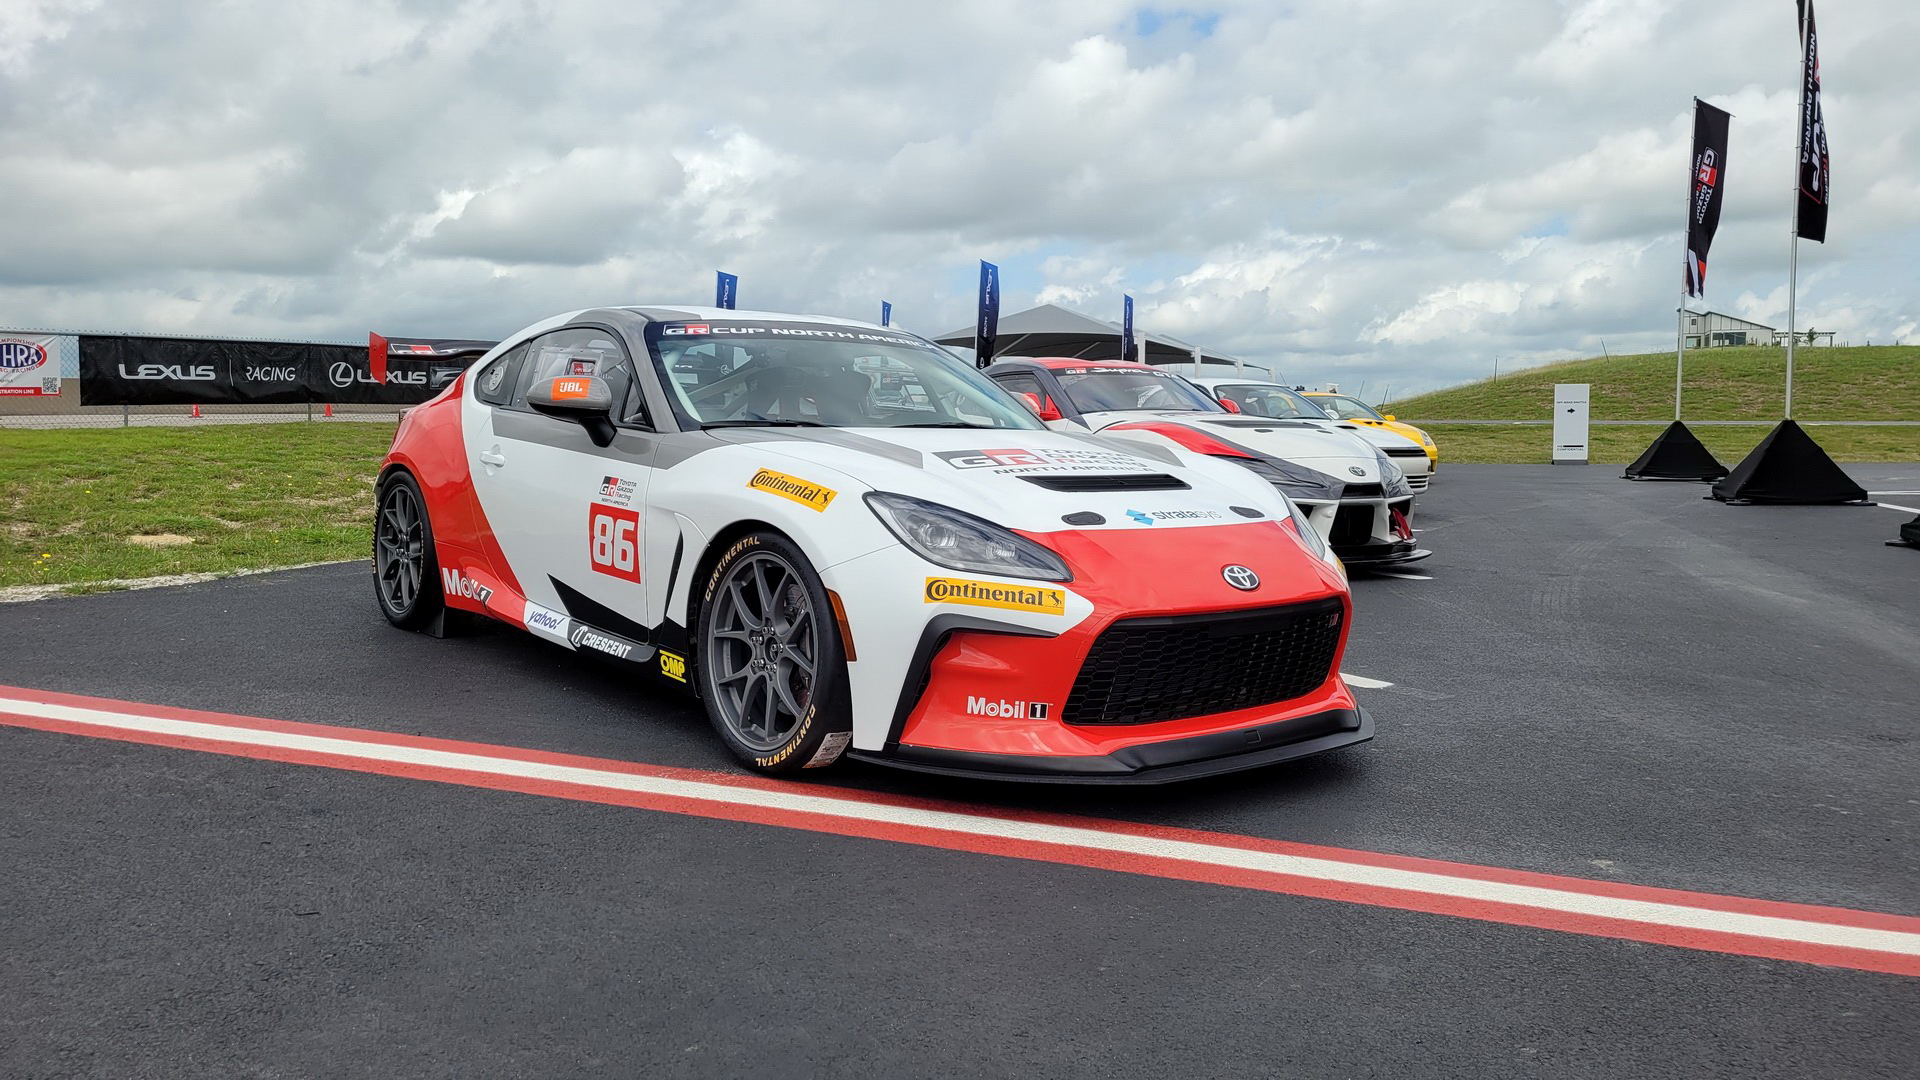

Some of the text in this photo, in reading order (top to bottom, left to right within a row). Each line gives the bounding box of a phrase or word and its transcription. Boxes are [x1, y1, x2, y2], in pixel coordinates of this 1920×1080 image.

[1802, 33, 1816, 163] NORTH AMERICA
[1698, 149, 1715, 183] GR
[1699, 188, 1713, 224] TOYOTA
[664, 326, 709, 335] GR
[771, 328, 854, 338] NORTH
[859, 334, 939, 351] AMERICA
[2, 344, 38, 367] HRA
[12, 365, 36, 374] RACING
[118, 364, 296, 381] LEXUS RACING
[357, 369, 426, 384] LXUS
[560, 382, 582, 392] JBL
[948, 452, 1045, 469] GR
[994, 466, 1068, 474] NORTH
[600, 484, 615, 496] GR
[616, 486, 634, 494] GAZOO
[620, 479, 637, 488] TOYOTA
[750, 470, 822, 502] Continental
[614, 492, 632, 502] Racing
[1152, 510, 1222, 520] stratasys
[592, 514, 635, 572] 86
[704, 536, 760, 602] CONTINENTAL
[926, 580, 1044, 606] Continental
[528, 610, 564, 630] yahoo!
[582, 632, 632, 658] CRESCENT
[660, 654, 686, 678] OMP
[966, 696, 1025, 719] Mobil
[755, 704, 816, 767] CONTINENTAL
